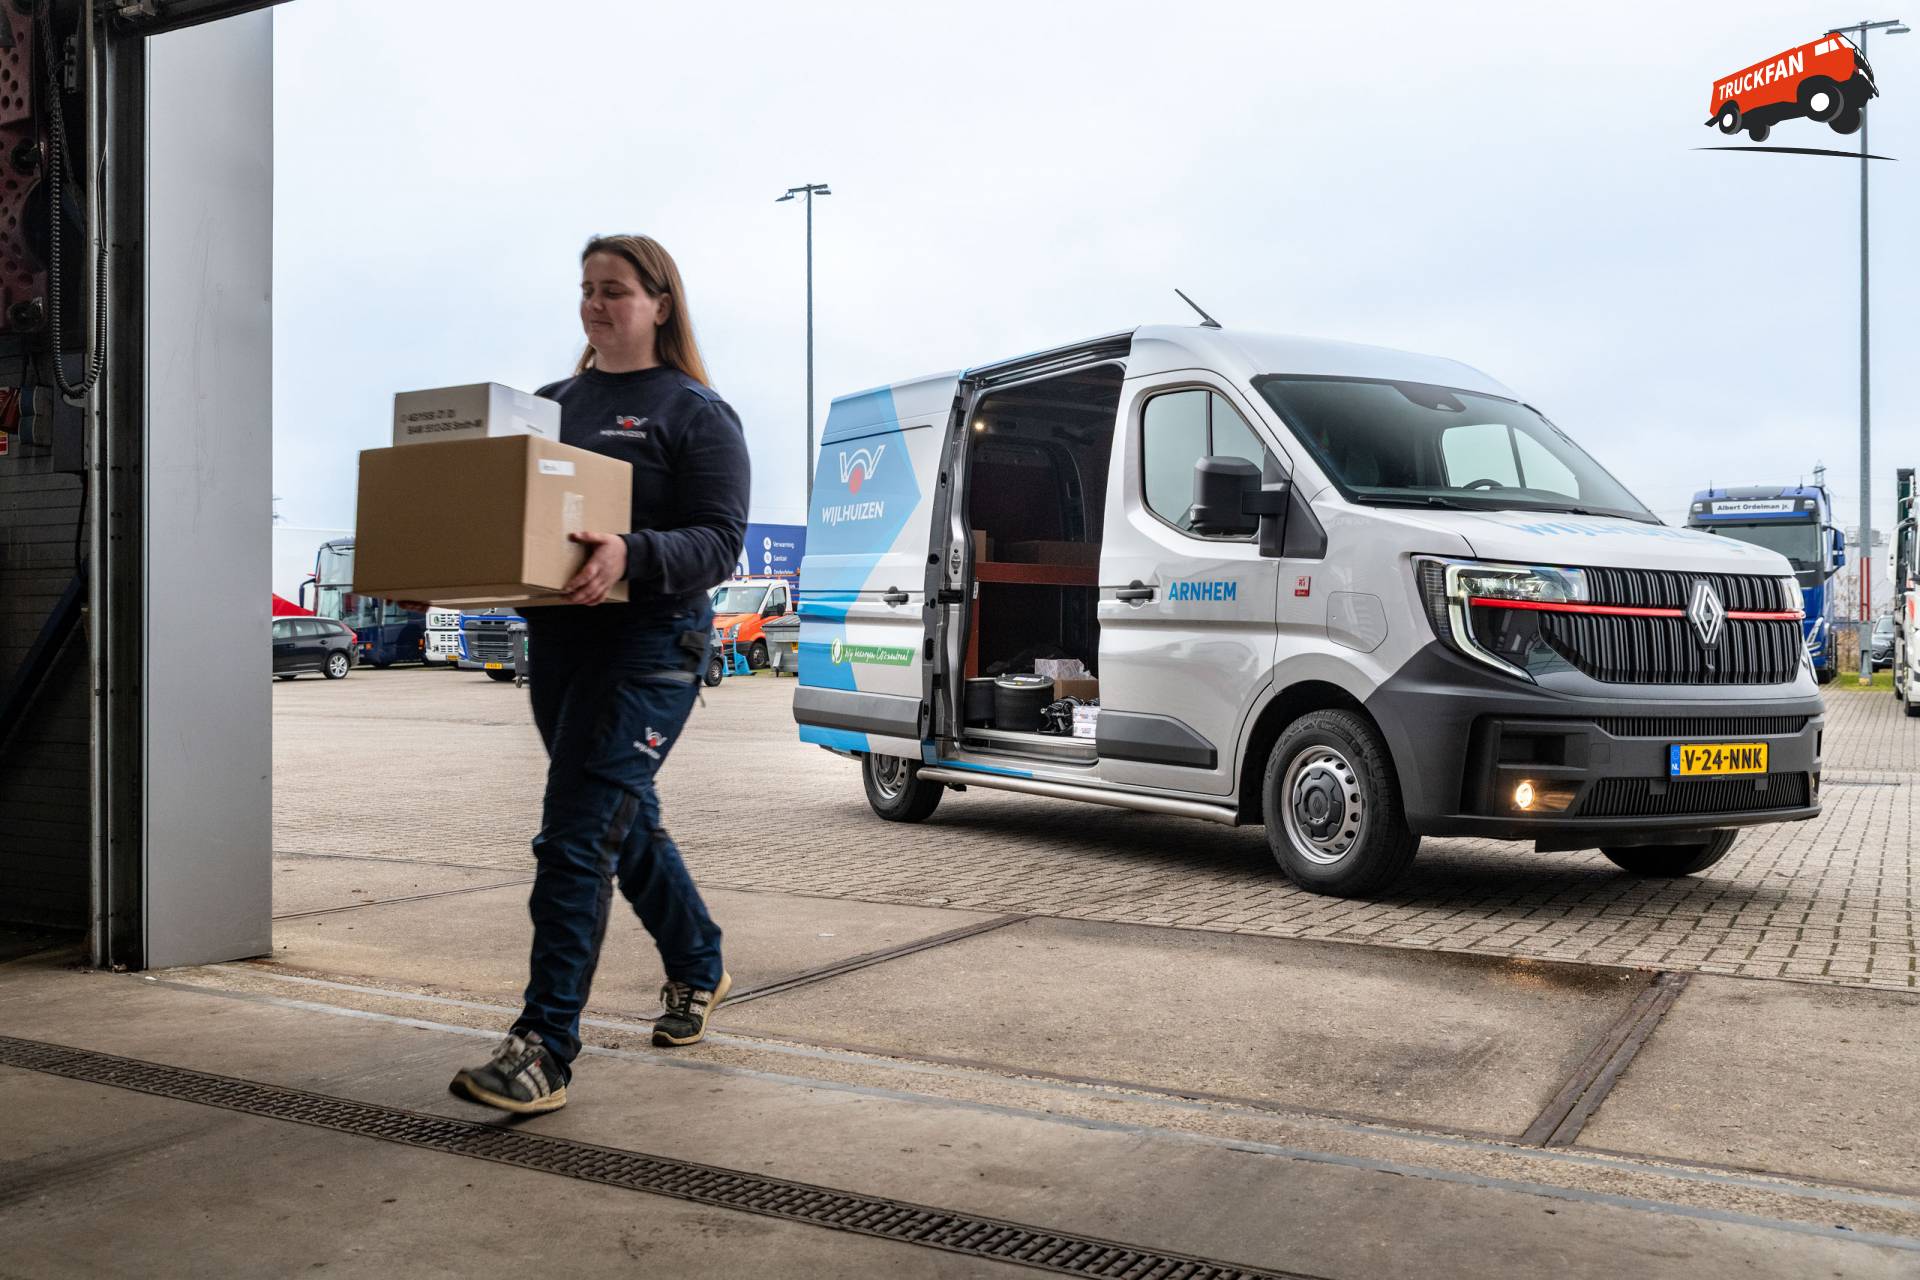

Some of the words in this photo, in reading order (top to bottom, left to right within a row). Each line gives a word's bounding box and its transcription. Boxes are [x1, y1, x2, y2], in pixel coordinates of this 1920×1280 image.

[822, 501, 884, 527] WIJLHUIZEN
[1717, 503, 1741, 511] Albert
[1168, 581, 1237, 601] ARNHEM
[1684, 747, 1763, 771] V-24-NNK
